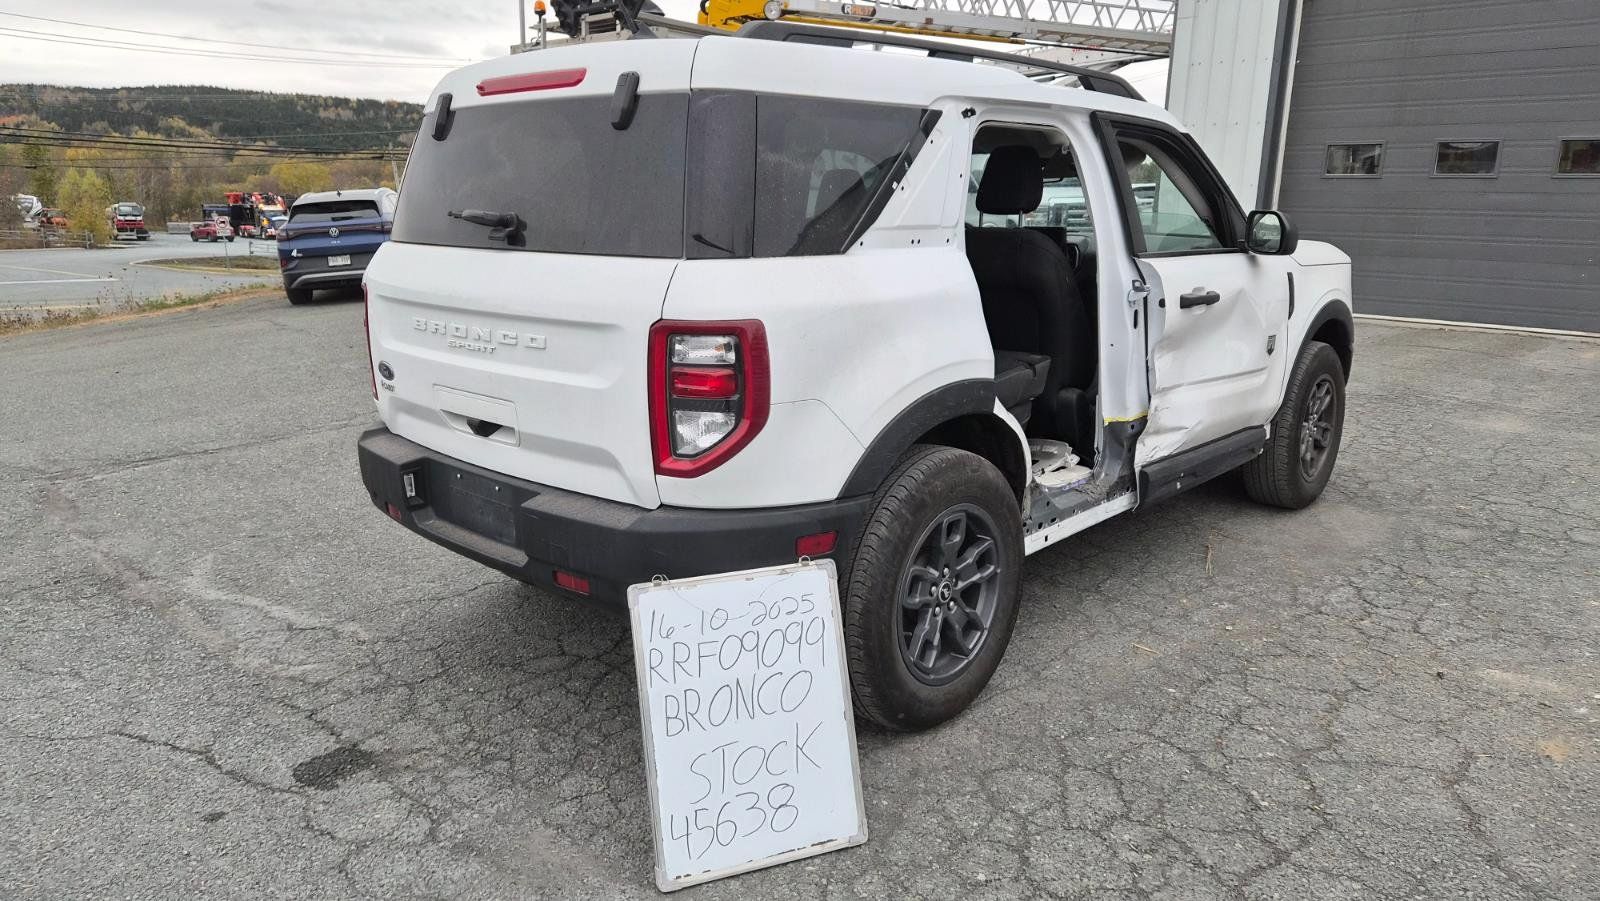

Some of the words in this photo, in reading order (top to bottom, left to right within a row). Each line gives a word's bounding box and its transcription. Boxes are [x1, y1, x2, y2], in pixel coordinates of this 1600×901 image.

[414, 317, 546, 349] BRONCO
[448, 339, 496, 353] SPORT
[649, 617, 825, 688] RRF09099
[665, 671, 812, 737] BRONCO
[690, 722, 823, 803] STOCK
[671, 784, 798, 859] 45638
